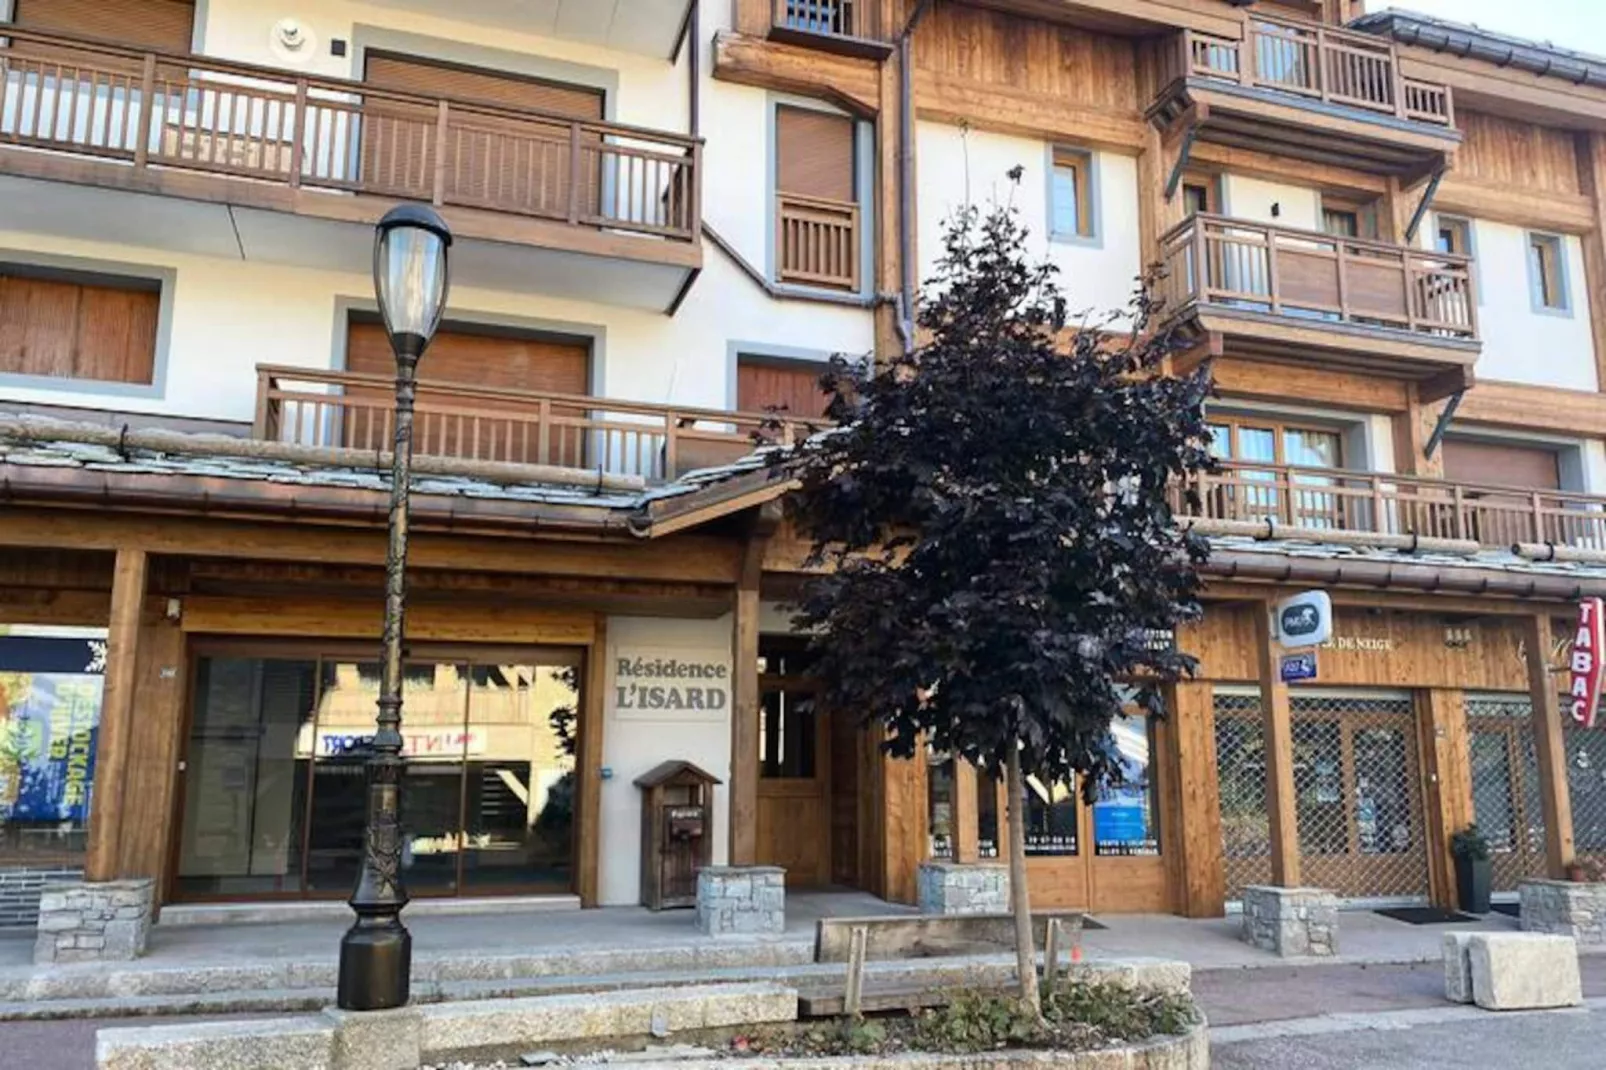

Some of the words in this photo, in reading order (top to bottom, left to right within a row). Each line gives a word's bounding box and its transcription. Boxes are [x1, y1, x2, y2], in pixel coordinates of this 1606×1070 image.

[616, 657, 727, 678] Résidence
[1571, 603, 1593, 721] TABAC
[616, 683, 726, 709] L'ISARD
